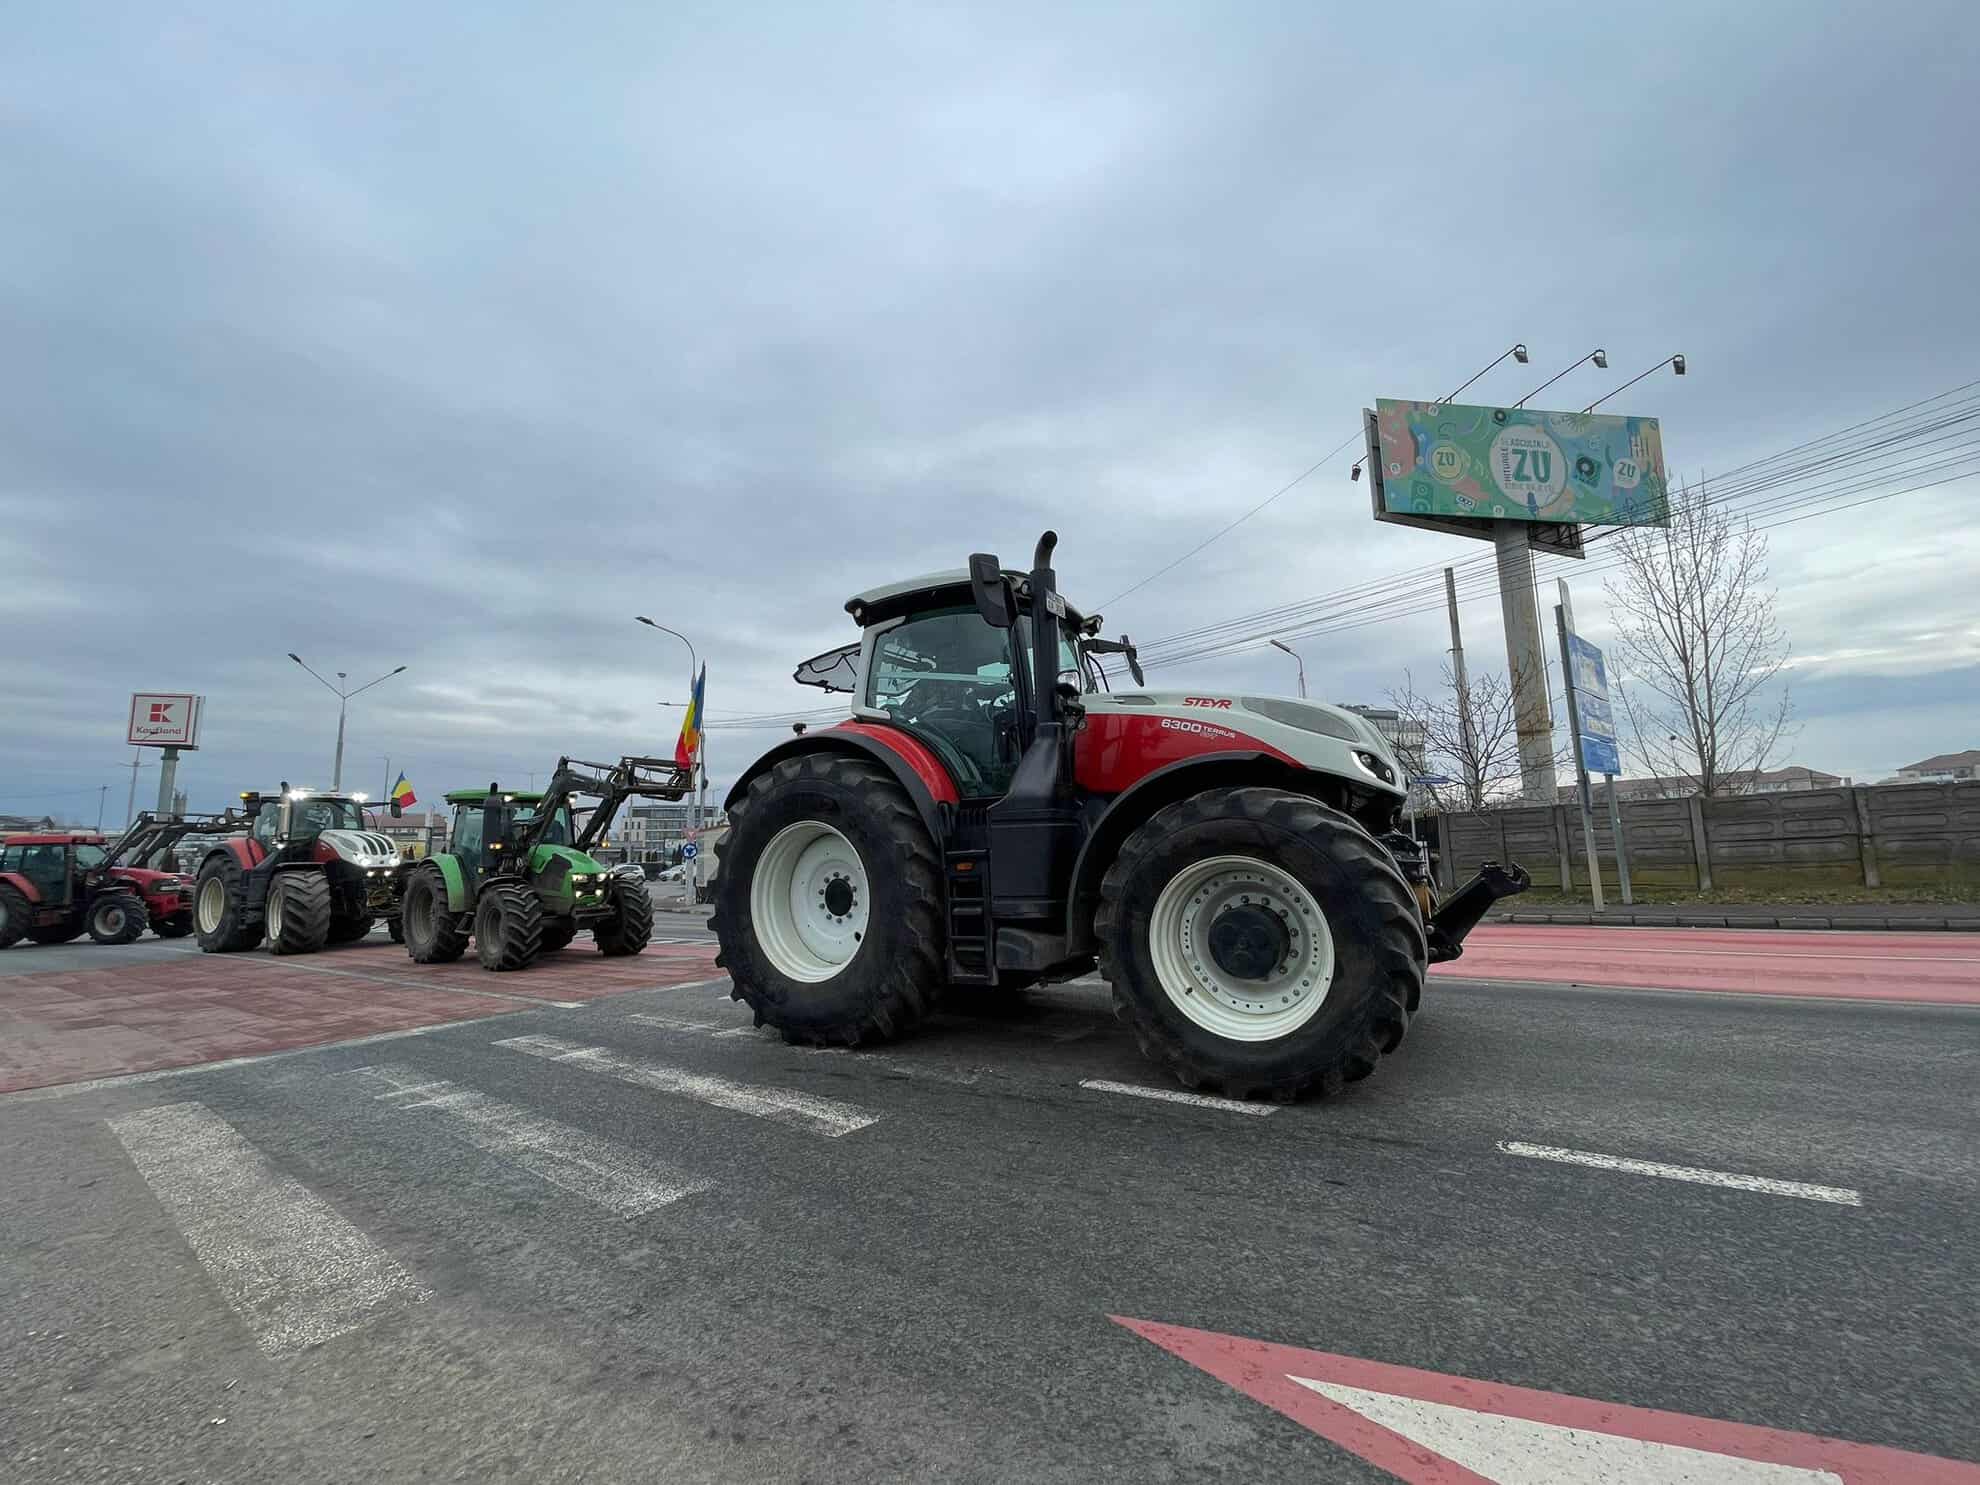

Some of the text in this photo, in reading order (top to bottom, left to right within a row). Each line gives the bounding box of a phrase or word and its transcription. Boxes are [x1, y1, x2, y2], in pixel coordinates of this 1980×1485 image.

[1437, 451, 1455, 466] ZU
[1511, 448, 1551, 483] ZU
[1617, 461, 1636, 478] ZU
[1182, 697, 1233, 709] STEYR
[1161, 718, 1202, 733] 6300
[1203, 725, 1236, 738] TERRUS
